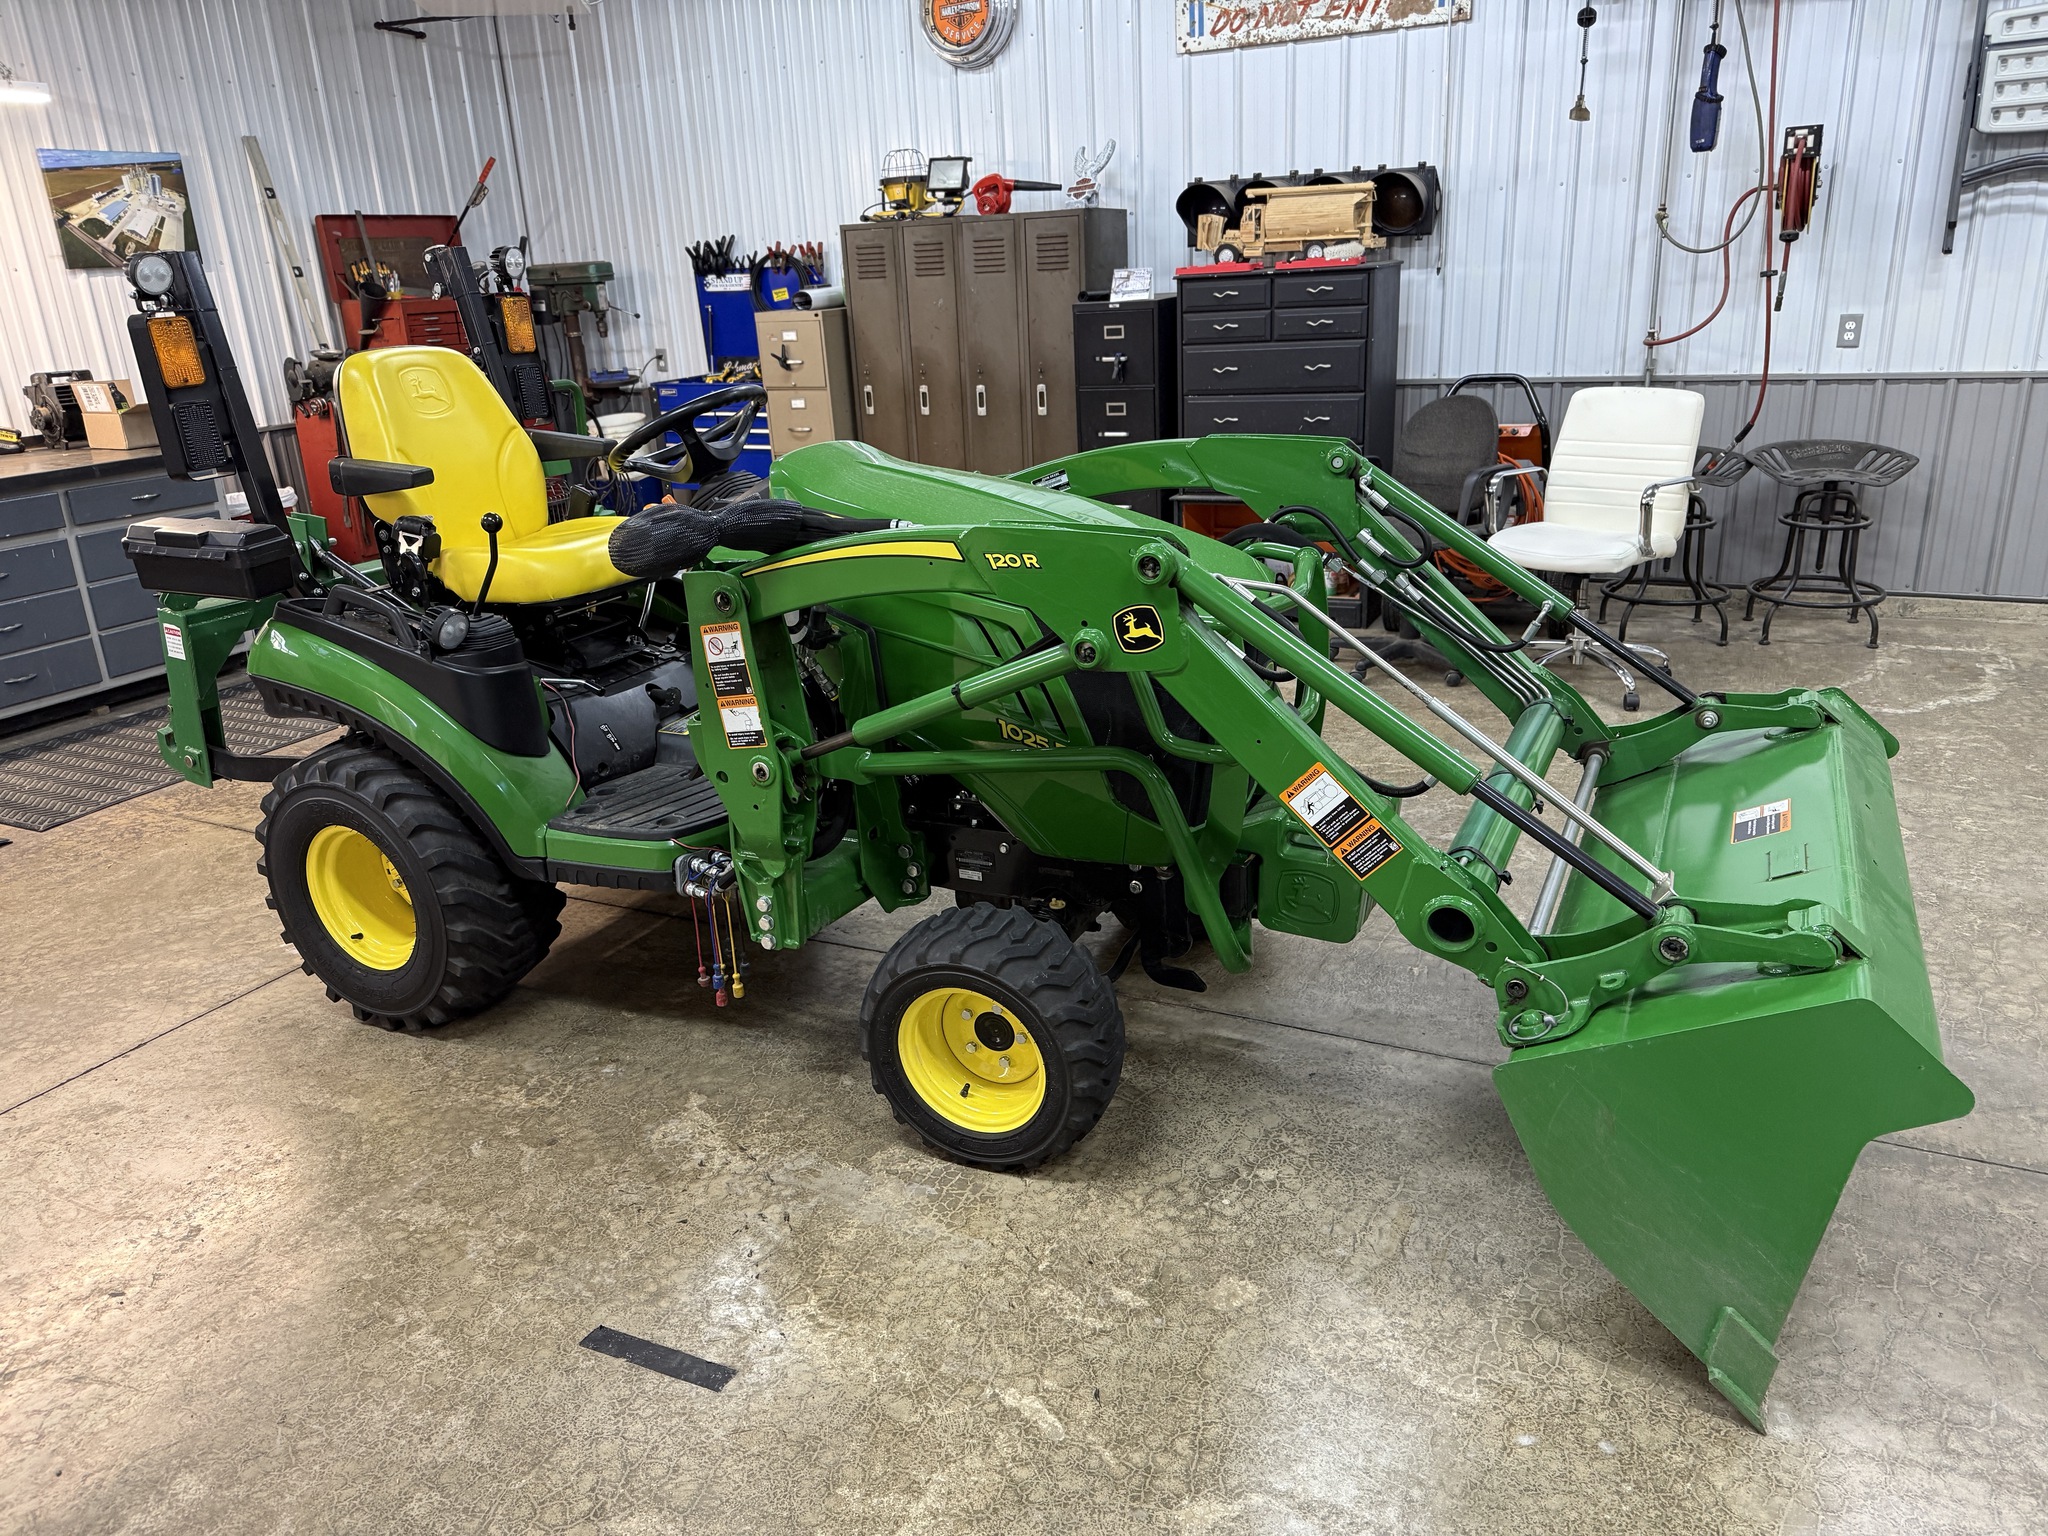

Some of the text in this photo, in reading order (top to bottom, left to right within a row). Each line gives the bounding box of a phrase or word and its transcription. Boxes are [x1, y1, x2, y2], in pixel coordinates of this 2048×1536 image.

[944, 21, 980, 40] SERVICE
[1209, 8, 1247, 37] DO
[707, 623, 739, 634] WARNING
[724, 697, 755, 707] WARNING
[996, 717, 1067, 748] 1025
[1292, 768, 1320, 794] WARNING
[1346, 823, 1376, 849] WARNING
